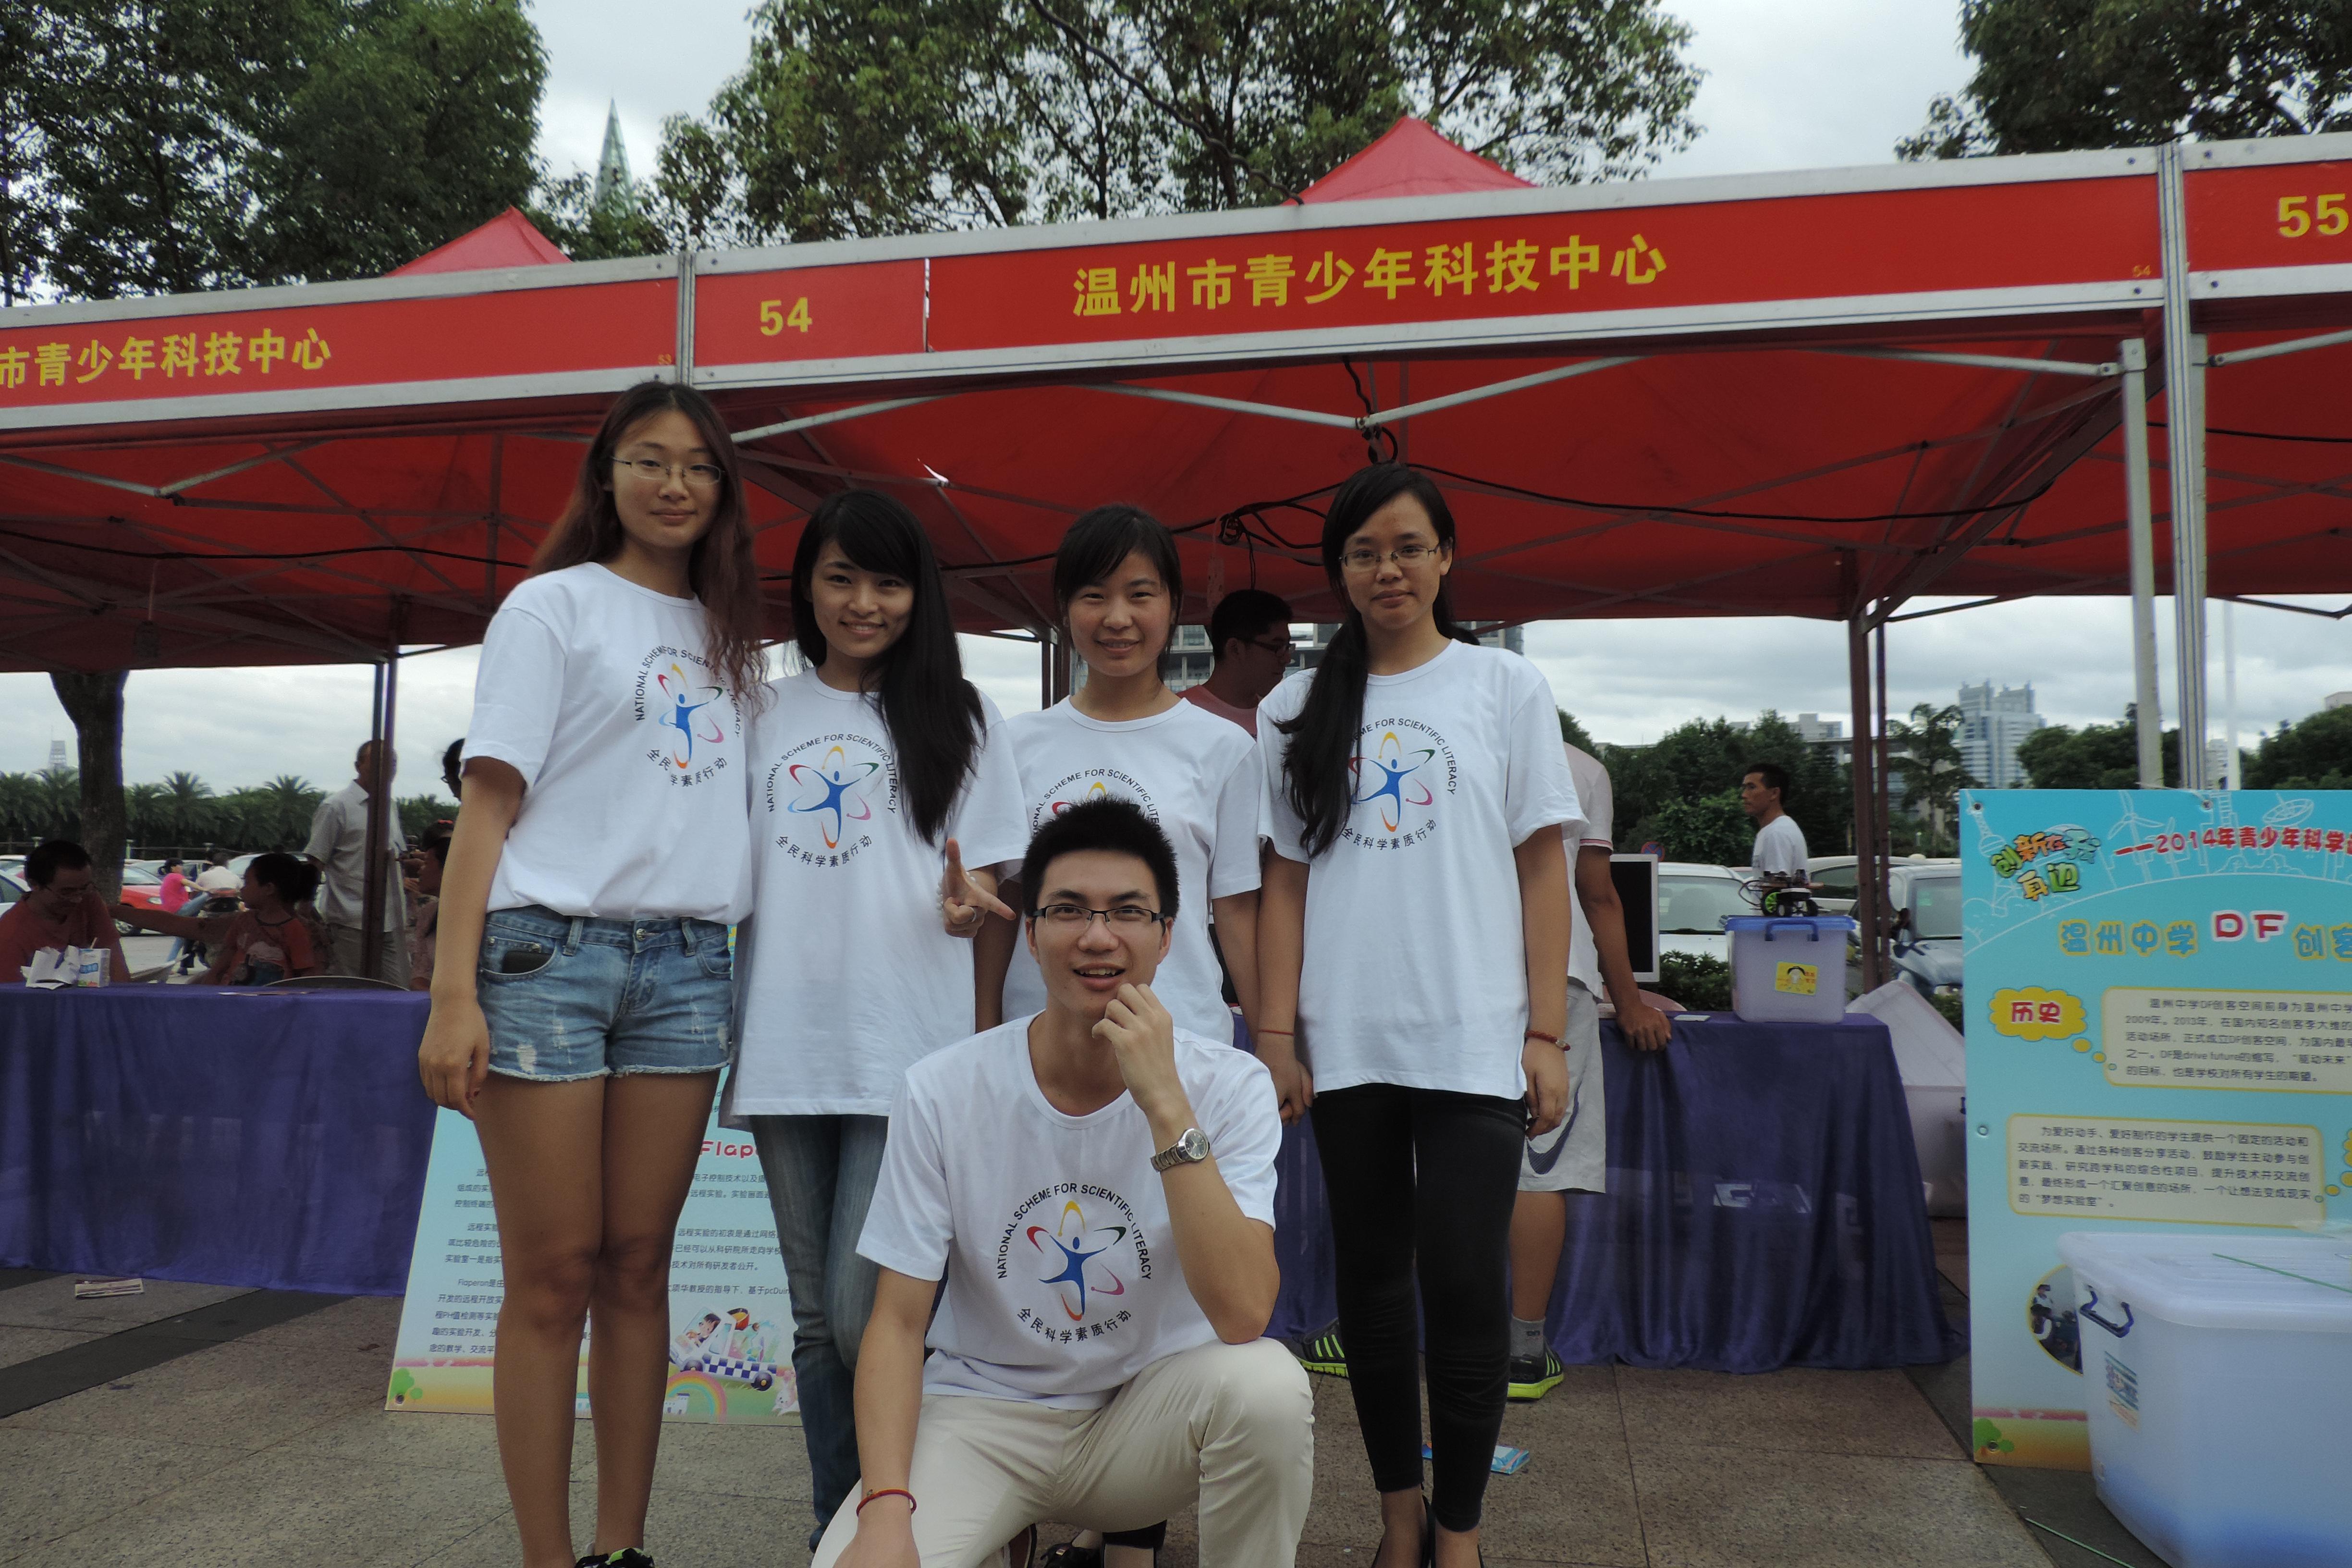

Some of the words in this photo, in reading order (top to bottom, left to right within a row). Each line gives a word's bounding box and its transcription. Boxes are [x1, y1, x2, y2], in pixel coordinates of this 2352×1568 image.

[2278, 193, 2349, 238] 55
[1073, 233, 1667, 317] 温州市青少年科技中心
[759, 296, 813, 336] 54
[0, 327, 331, 389] 市青少年科技中心
[635, 671, 649, 721] NATIONAL
[766, 762, 783, 812] NATIONAL
[781, 737, 821, 761] SCHEME
[824, 734, 844, 742] FOR
[846, 734, 891, 761] SCIENTIFIC
[886, 762, 897, 814] LITERACY
[1375, 718, 1395, 729] FOR
[1397, 718, 1445, 746] SCIENTIFIC
[1441, 746, 1458, 796] LITERACY
[1043, 772, 1082, 800] SCHEME
[1085, 769, 1105, 777] FOR
[1107, 769, 1151, 803] SCIENTIFIC
[775, 834, 872, 868] 全民科学素质行动
[1341, 819, 1437, 851] 全民科学素质行动
[2059, 919, 2198, 956] 温州中学
[2213, 911, 2286, 940] DF
[2011, 1001, 2062, 1024] 历史
[997, 1222, 1017, 1280] NATIONAL
[1014, 1186, 1052, 1221] SCHEME
[1054, 1183, 1078, 1196] FOR
[1081, 1184, 1134, 1223] SCIENTIFIC
[1130, 1222, 1152, 1280] LITERACY
[1017, 1307, 1132, 1345] 全民科学素质行动
